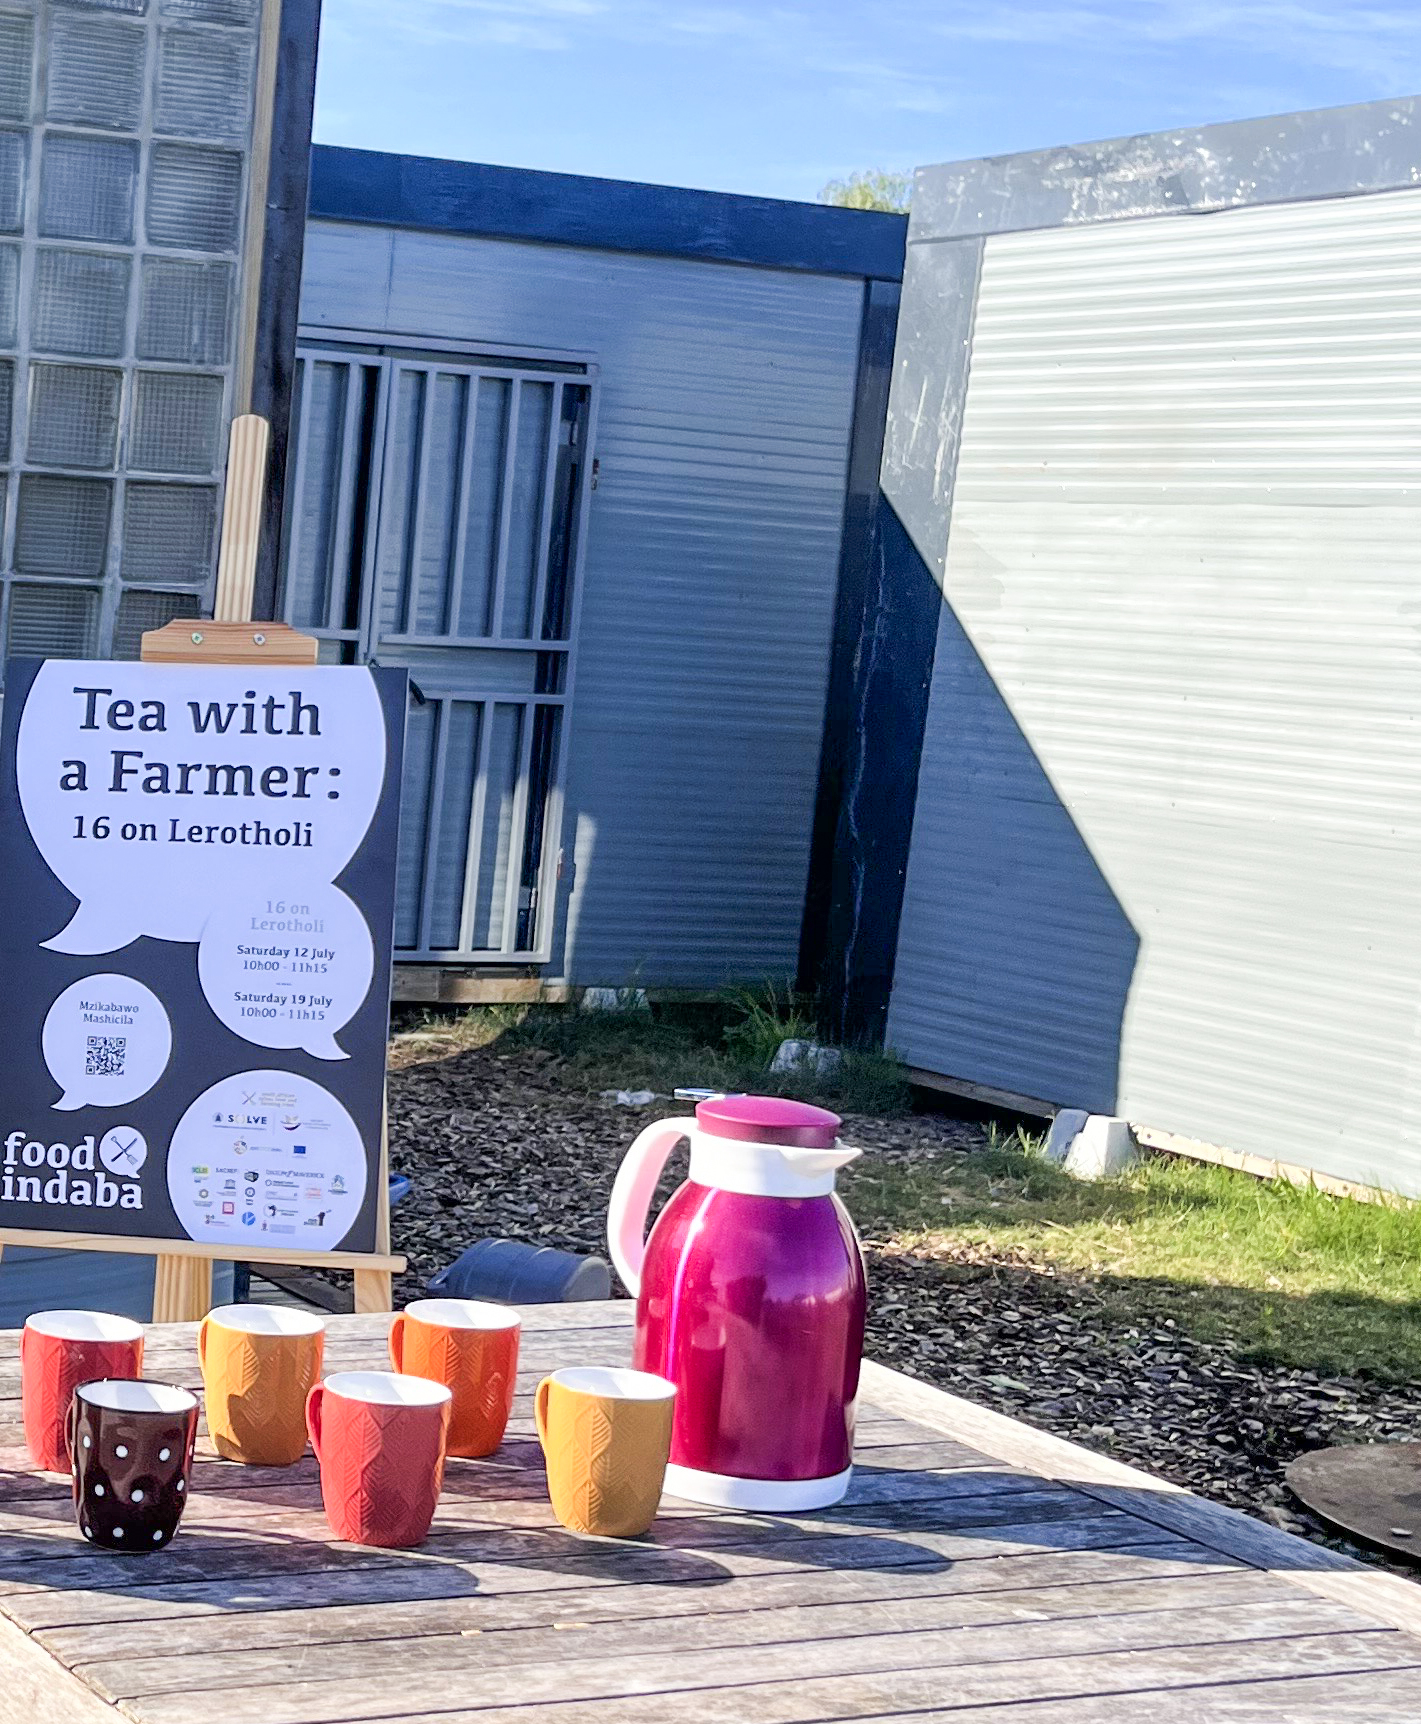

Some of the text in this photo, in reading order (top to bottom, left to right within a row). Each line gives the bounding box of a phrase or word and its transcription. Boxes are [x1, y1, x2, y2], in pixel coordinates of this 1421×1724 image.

[73, 686, 322, 736] Tea with
[59, 750, 342, 801] a Farmer:
[72, 815, 314, 848] 16 on Lerotholi
[265, 900, 311, 915] 16 on
[250, 917, 325, 933] Lerotholi
[236, 944, 336, 961] Saturday 12 July
[243, 960, 281, 971] 10h00
[290, 962, 328, 974] 11h15
[79, 1000, 140, 1013] Mzikabawo
[233, 991, 333, 1008] Saturday 19 July
[240, 1006, 278, 1018] 10h00
[288, 1009, 326, 1021] 11h15
[1, 1130, 96, 1171] food
[0, 1165, 145, 1210] indaba
